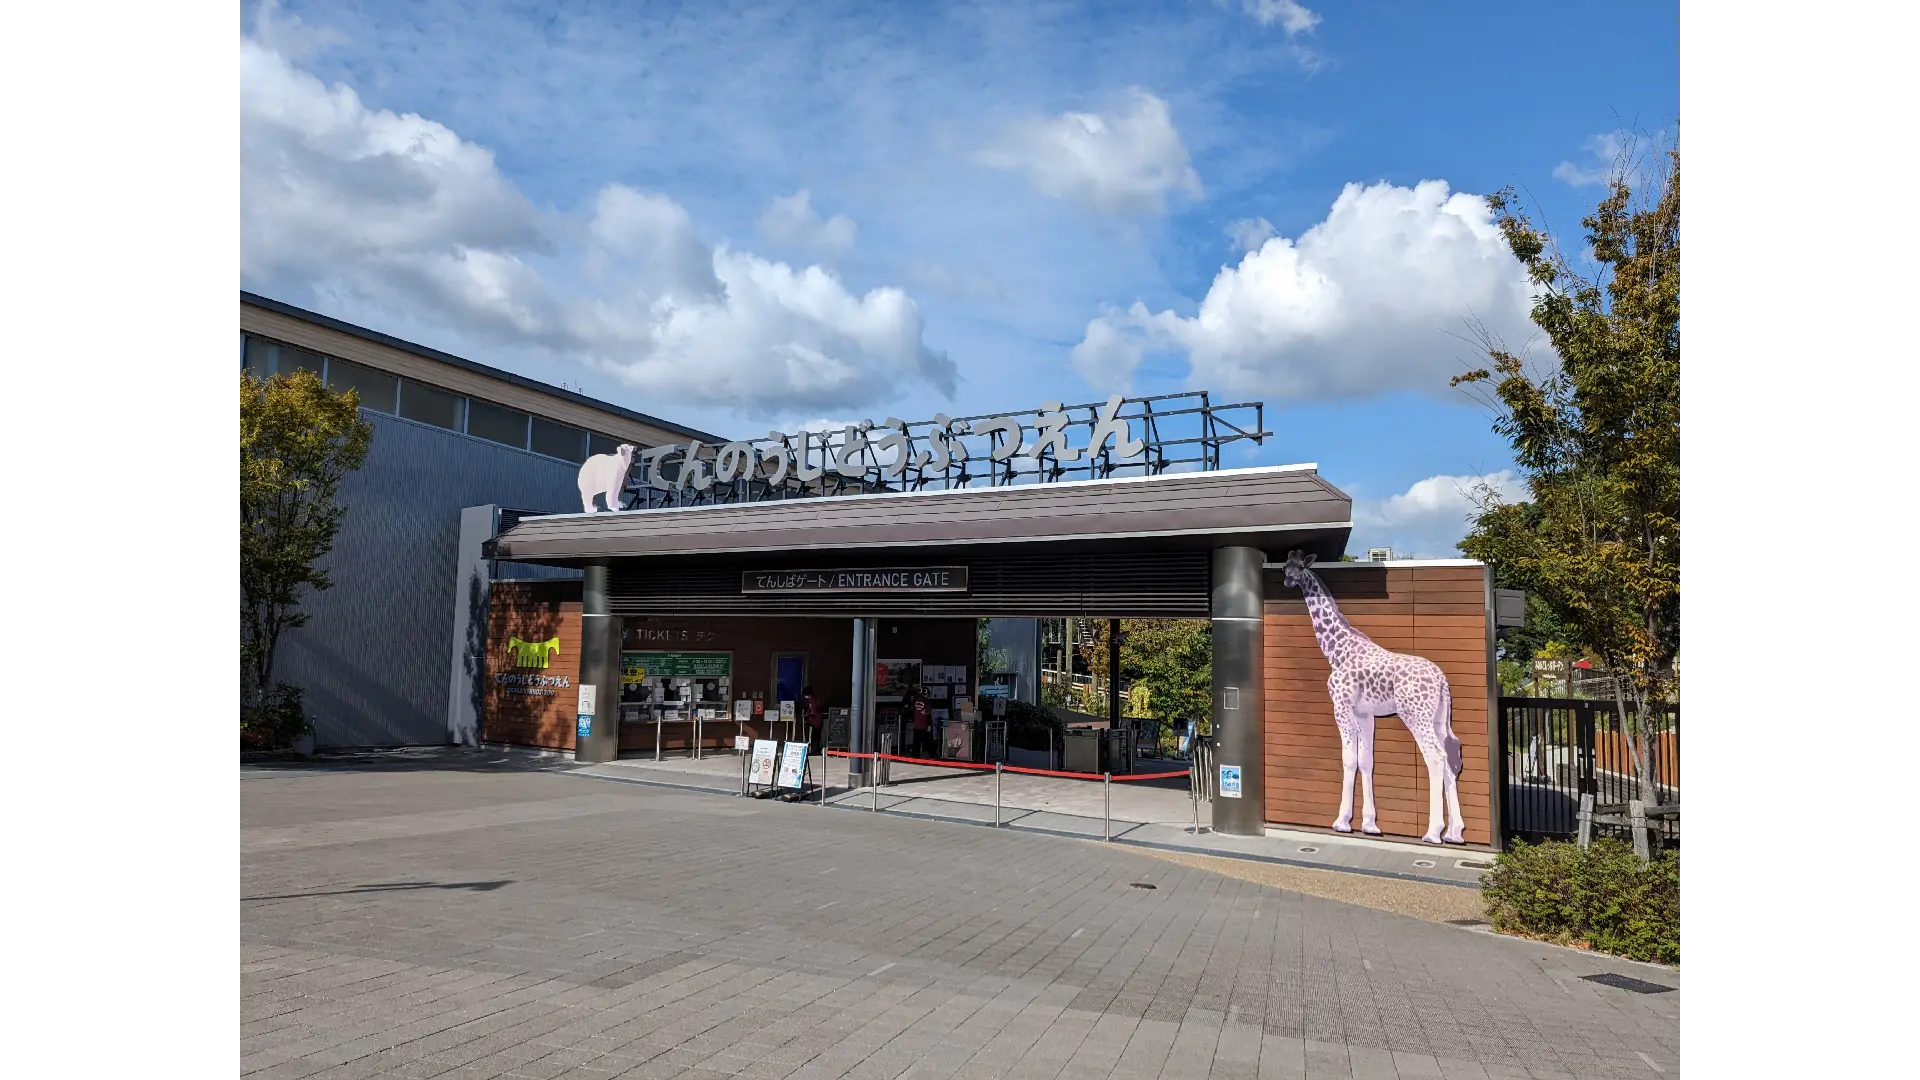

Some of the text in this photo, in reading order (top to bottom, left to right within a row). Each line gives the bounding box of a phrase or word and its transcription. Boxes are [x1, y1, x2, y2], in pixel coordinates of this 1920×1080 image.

[640, 394, 1144, 490] てんのうじどうぶつえん
[757, 575, 827, 589] てんしばゲート
[838, 573, 909, 587] ENTRANCE
[914, 572, 950, 587] GATE
[496, 672, 570, 688] てんのうじどうぶつえん
